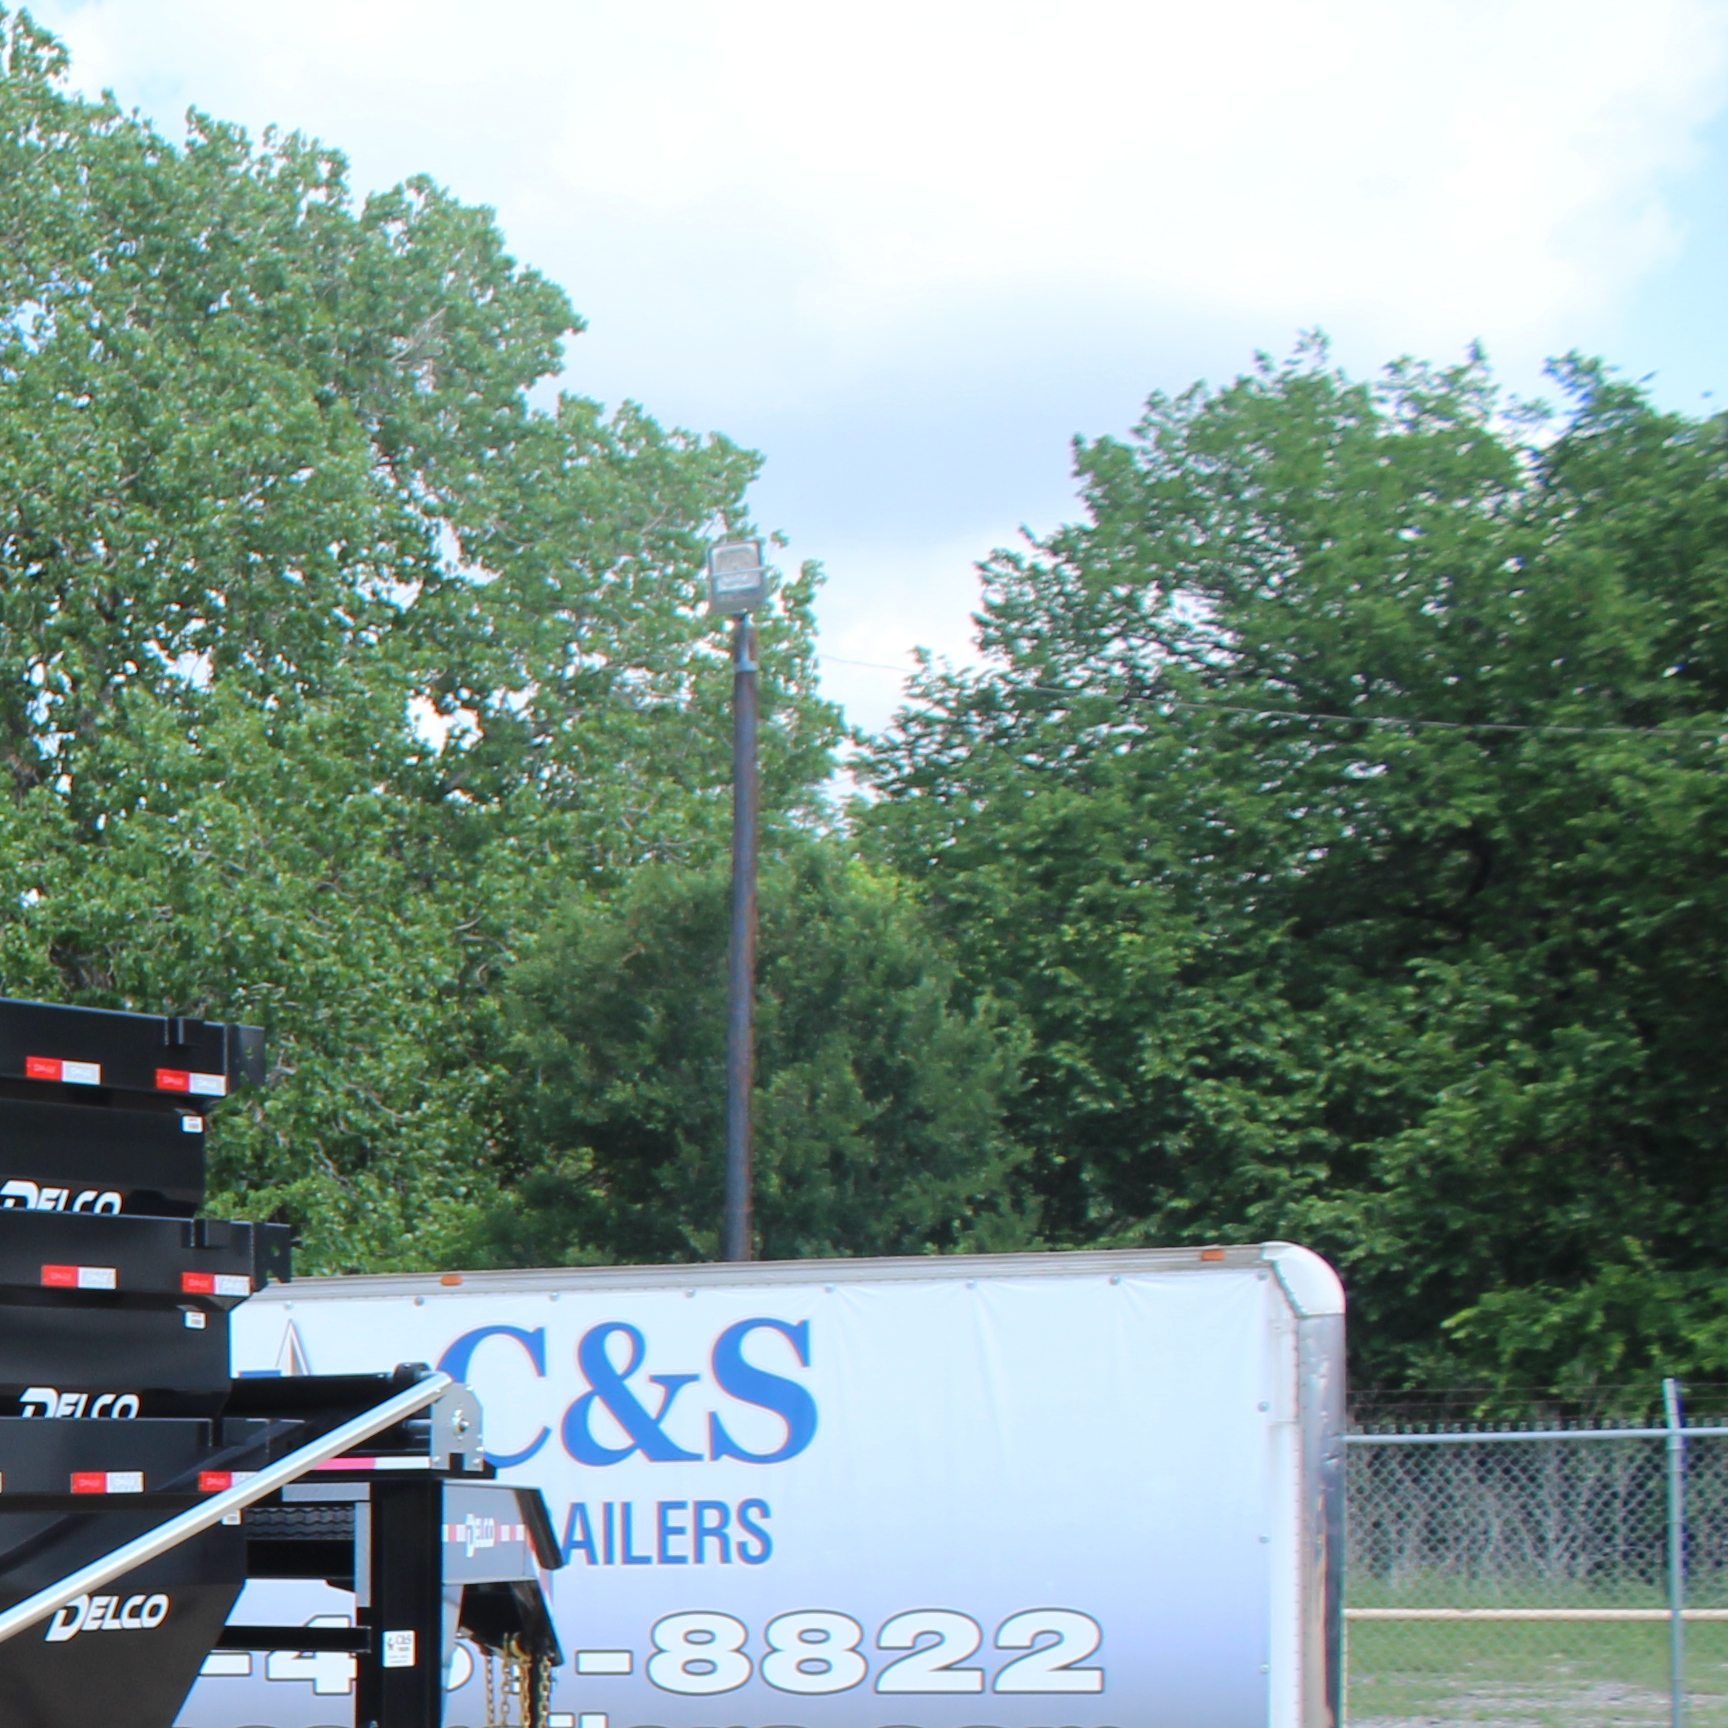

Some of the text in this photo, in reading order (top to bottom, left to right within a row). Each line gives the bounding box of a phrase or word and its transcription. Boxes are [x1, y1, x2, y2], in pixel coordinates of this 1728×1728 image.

[0, 1179, 123, 1213] DELCO
[19, 1386, 140, 1419] DELCO
[436, 1316, 819, 1468] C&S
[560, 1498, 774, 1566] AILERS
[44, 1592, 171, 1642] DELCO
